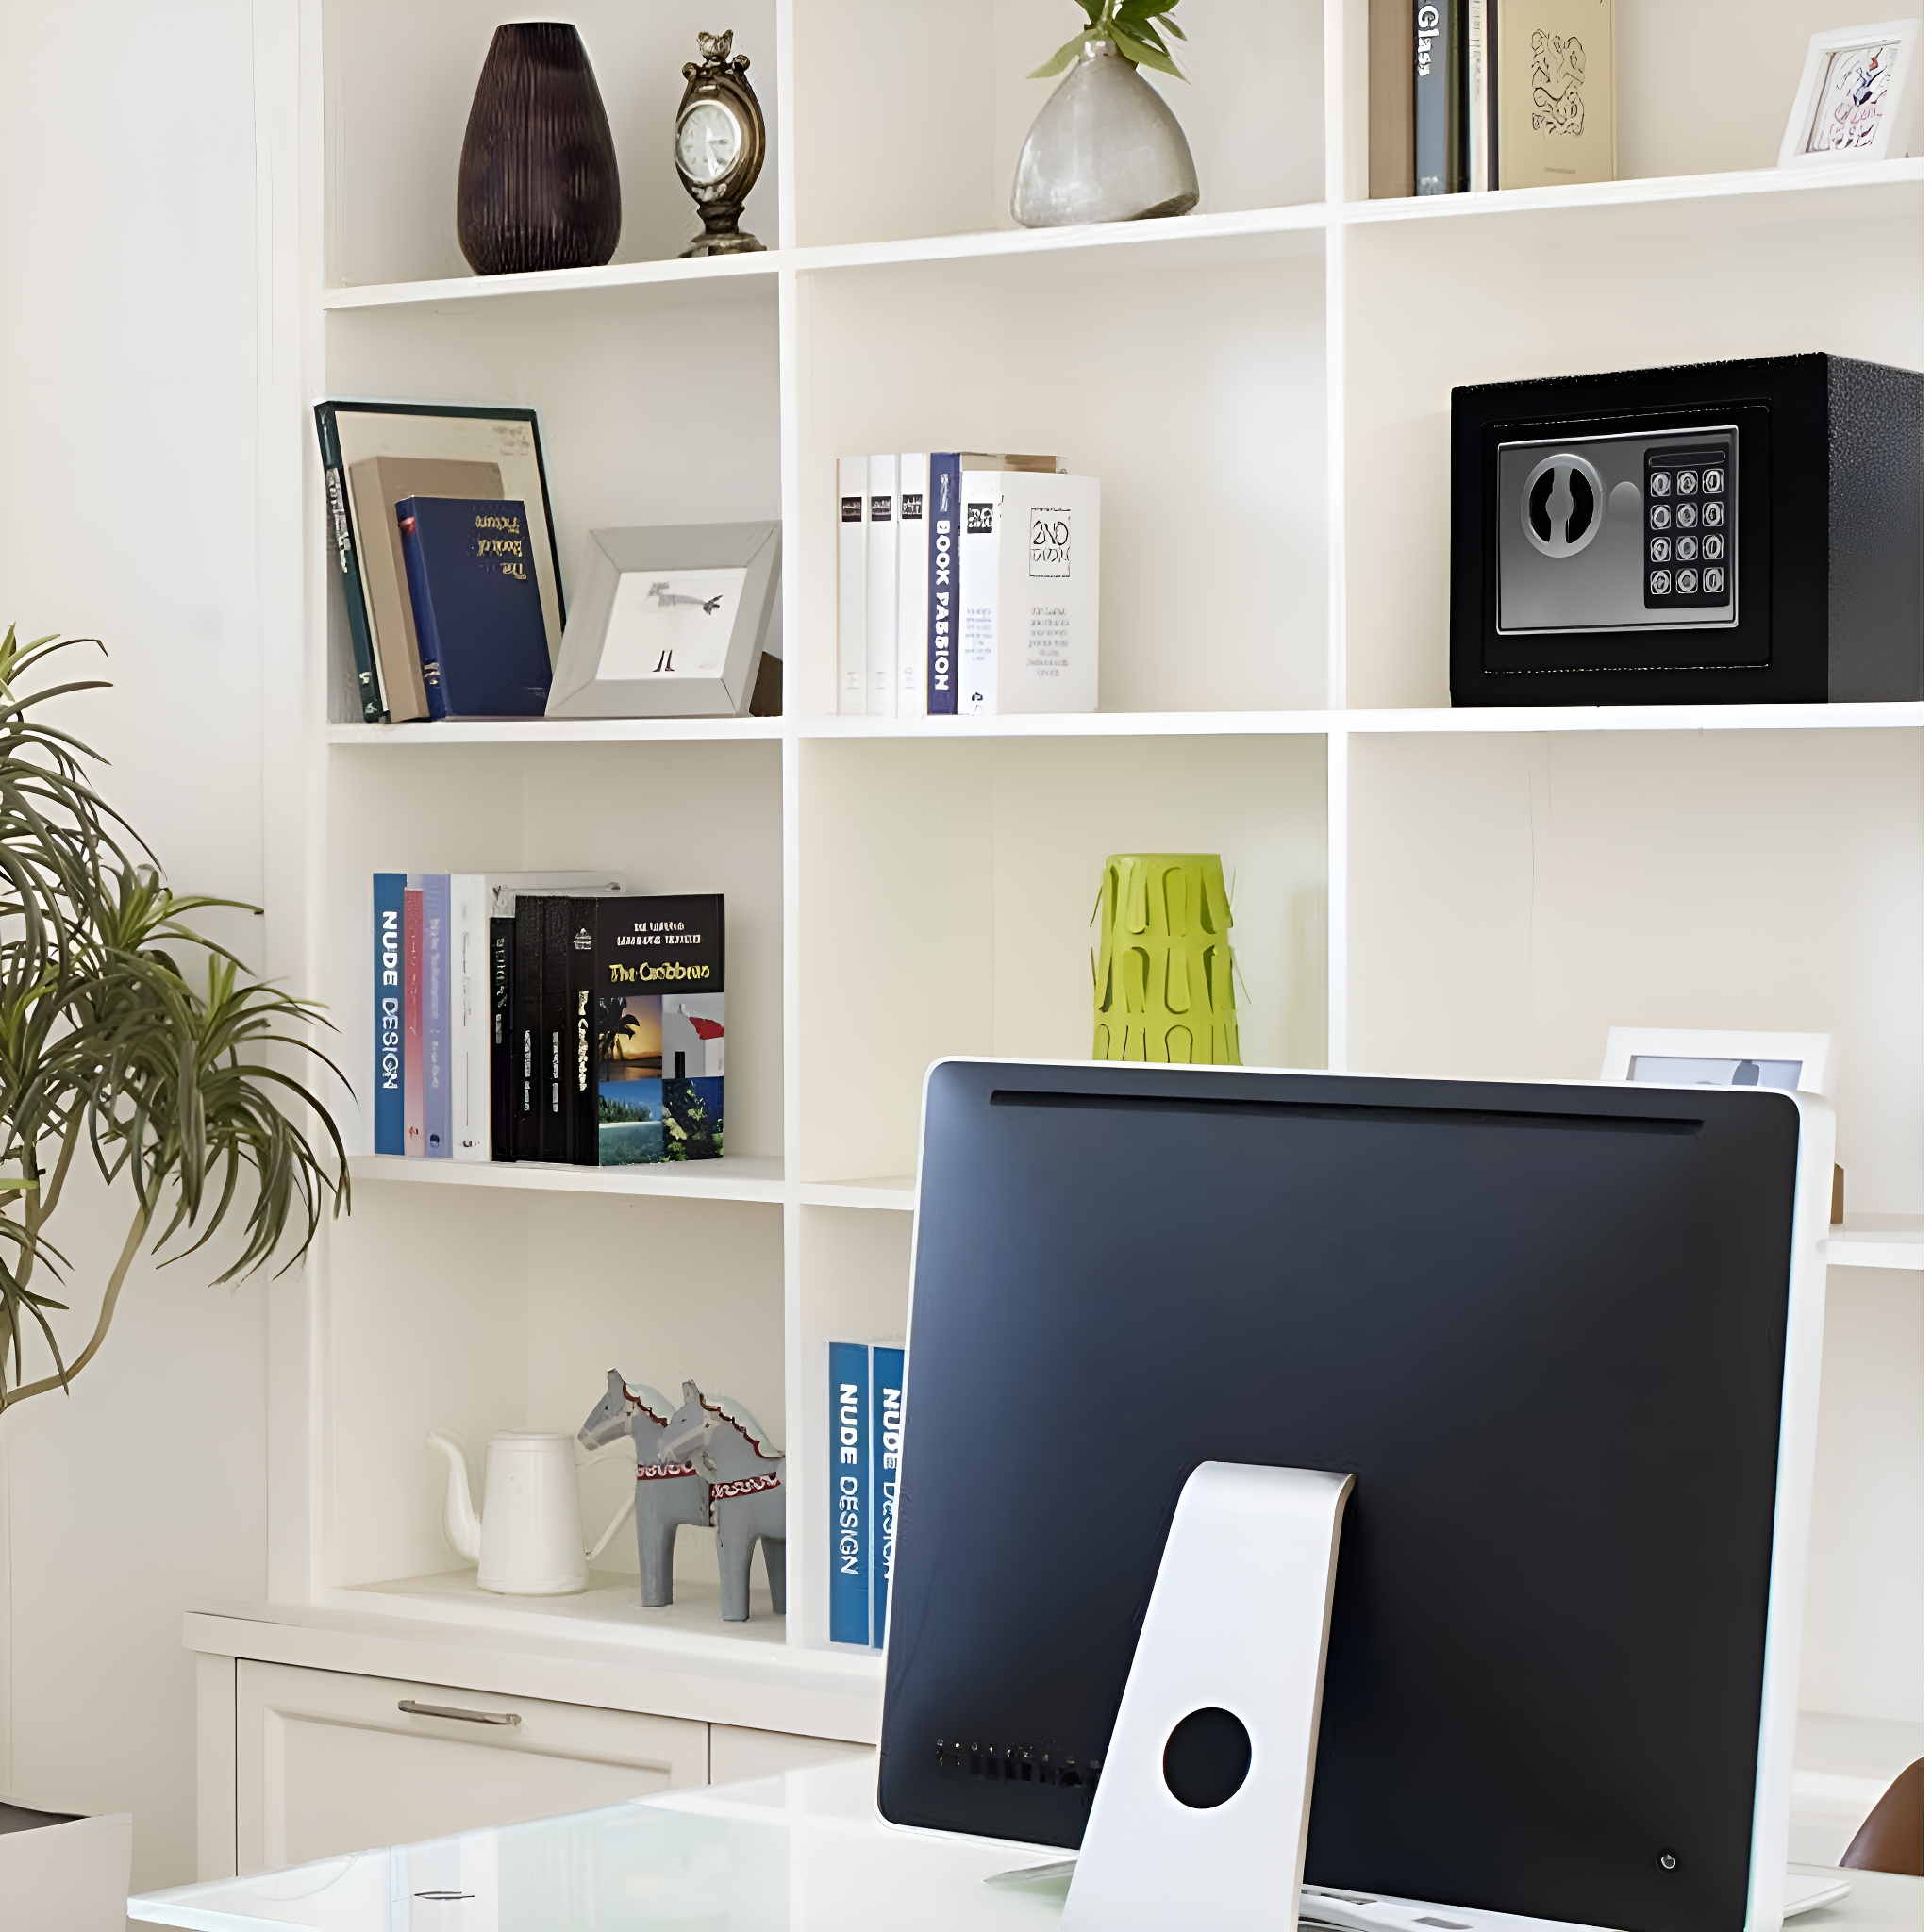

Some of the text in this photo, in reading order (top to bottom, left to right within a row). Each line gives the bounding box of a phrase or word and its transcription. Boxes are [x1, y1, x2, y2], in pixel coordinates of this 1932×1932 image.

[1417, 5, 1439, 77] Glass
[935, 520, 951, 585] BOOK
[382, 910, 399, 1090] NUDE DESIGN
[839, 1384, 858, 1574] NUDE DESIGN
